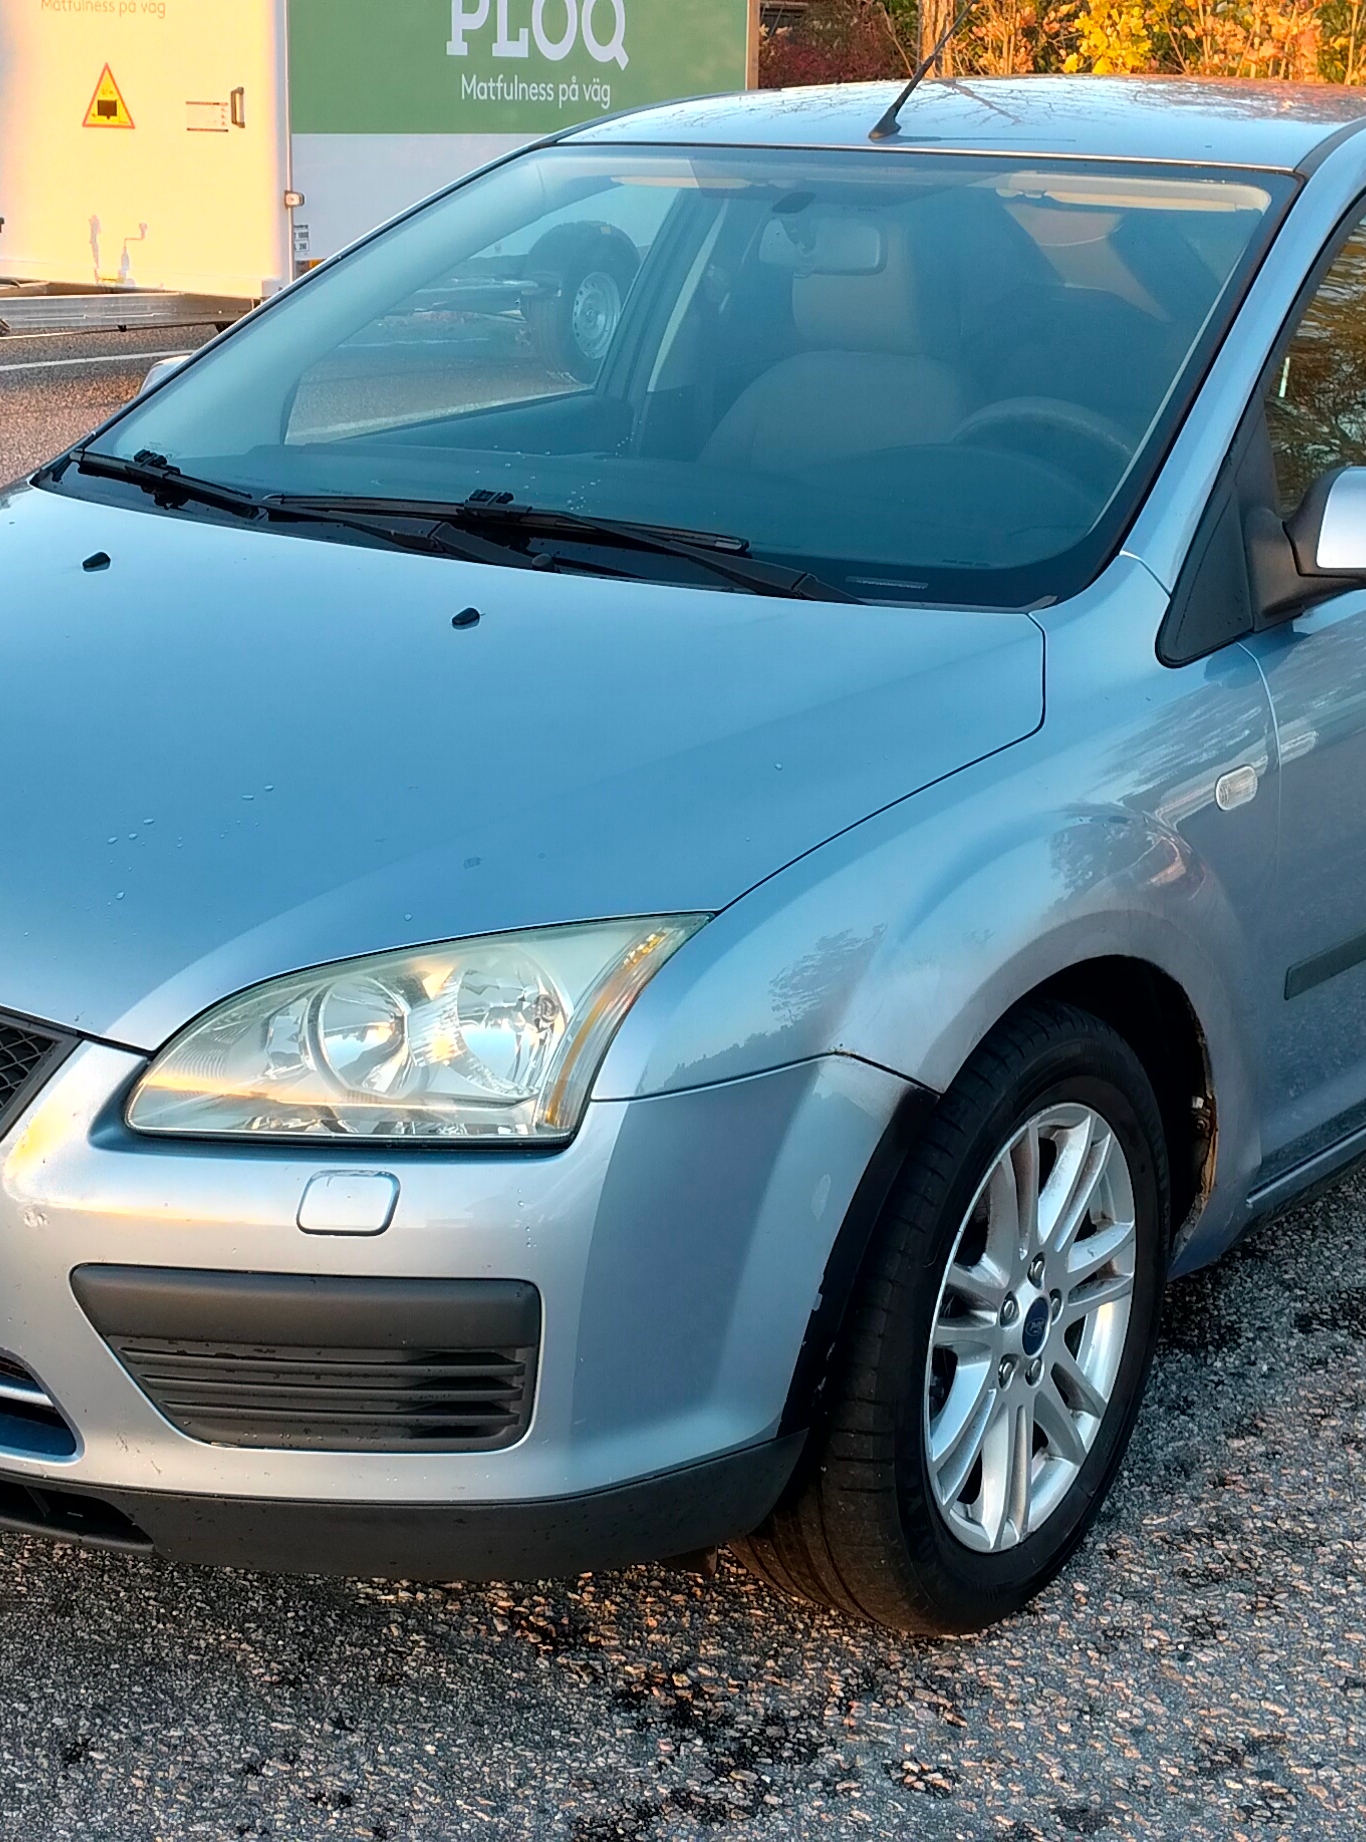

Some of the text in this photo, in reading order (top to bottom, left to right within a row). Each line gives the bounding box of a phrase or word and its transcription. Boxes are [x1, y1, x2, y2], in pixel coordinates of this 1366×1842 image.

[446, 0, 630, 71] PLOQ
[461, 73, 611, 110] Matfulness på väg
